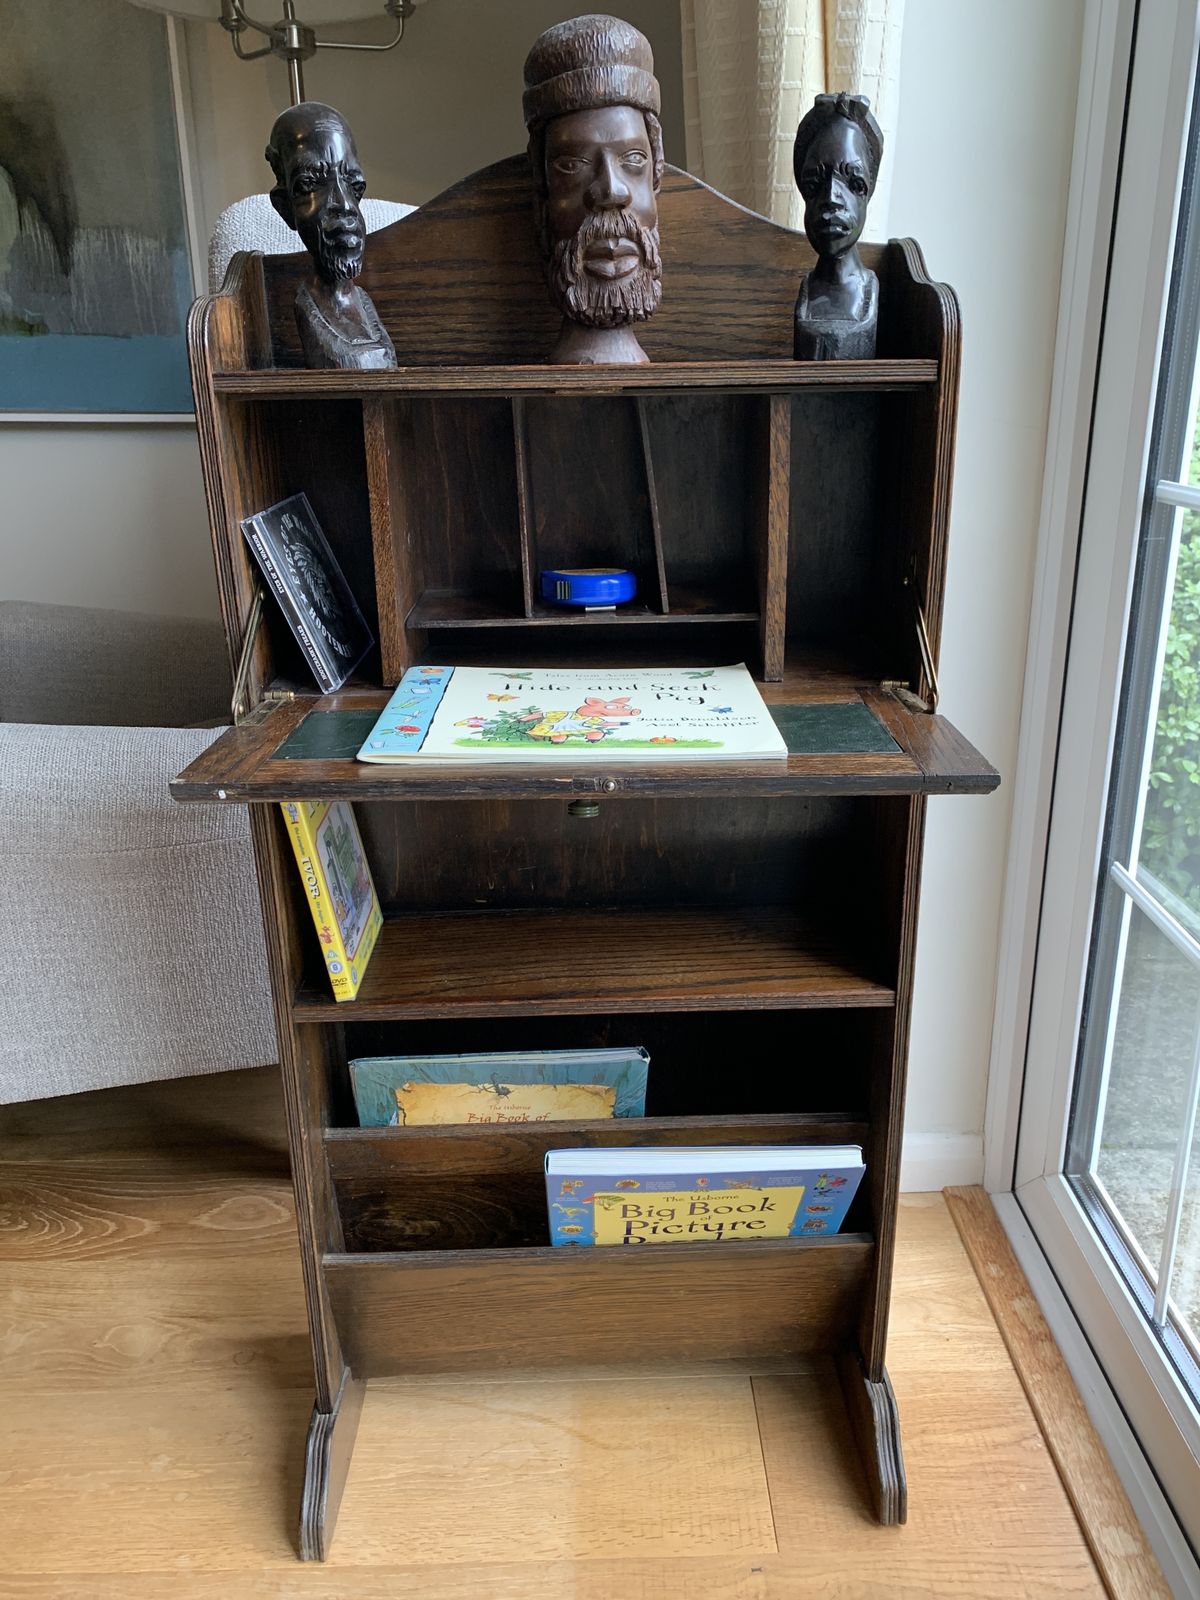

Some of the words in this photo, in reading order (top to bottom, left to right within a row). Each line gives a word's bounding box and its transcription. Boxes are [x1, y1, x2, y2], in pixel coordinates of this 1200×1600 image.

[655, 692, 706, 705] Pig
[301, 856, 321, 900] IVOR
[496, 1112, 530, 1123] Book
[536, 1112, 552, 1121] of
[690, 1194, 740, 1202] Usborne
[620, 1204, 676, 1221] Big
[687, 1197, 777, 1216] Book
[624, 1219, 767, 1236] Picture
